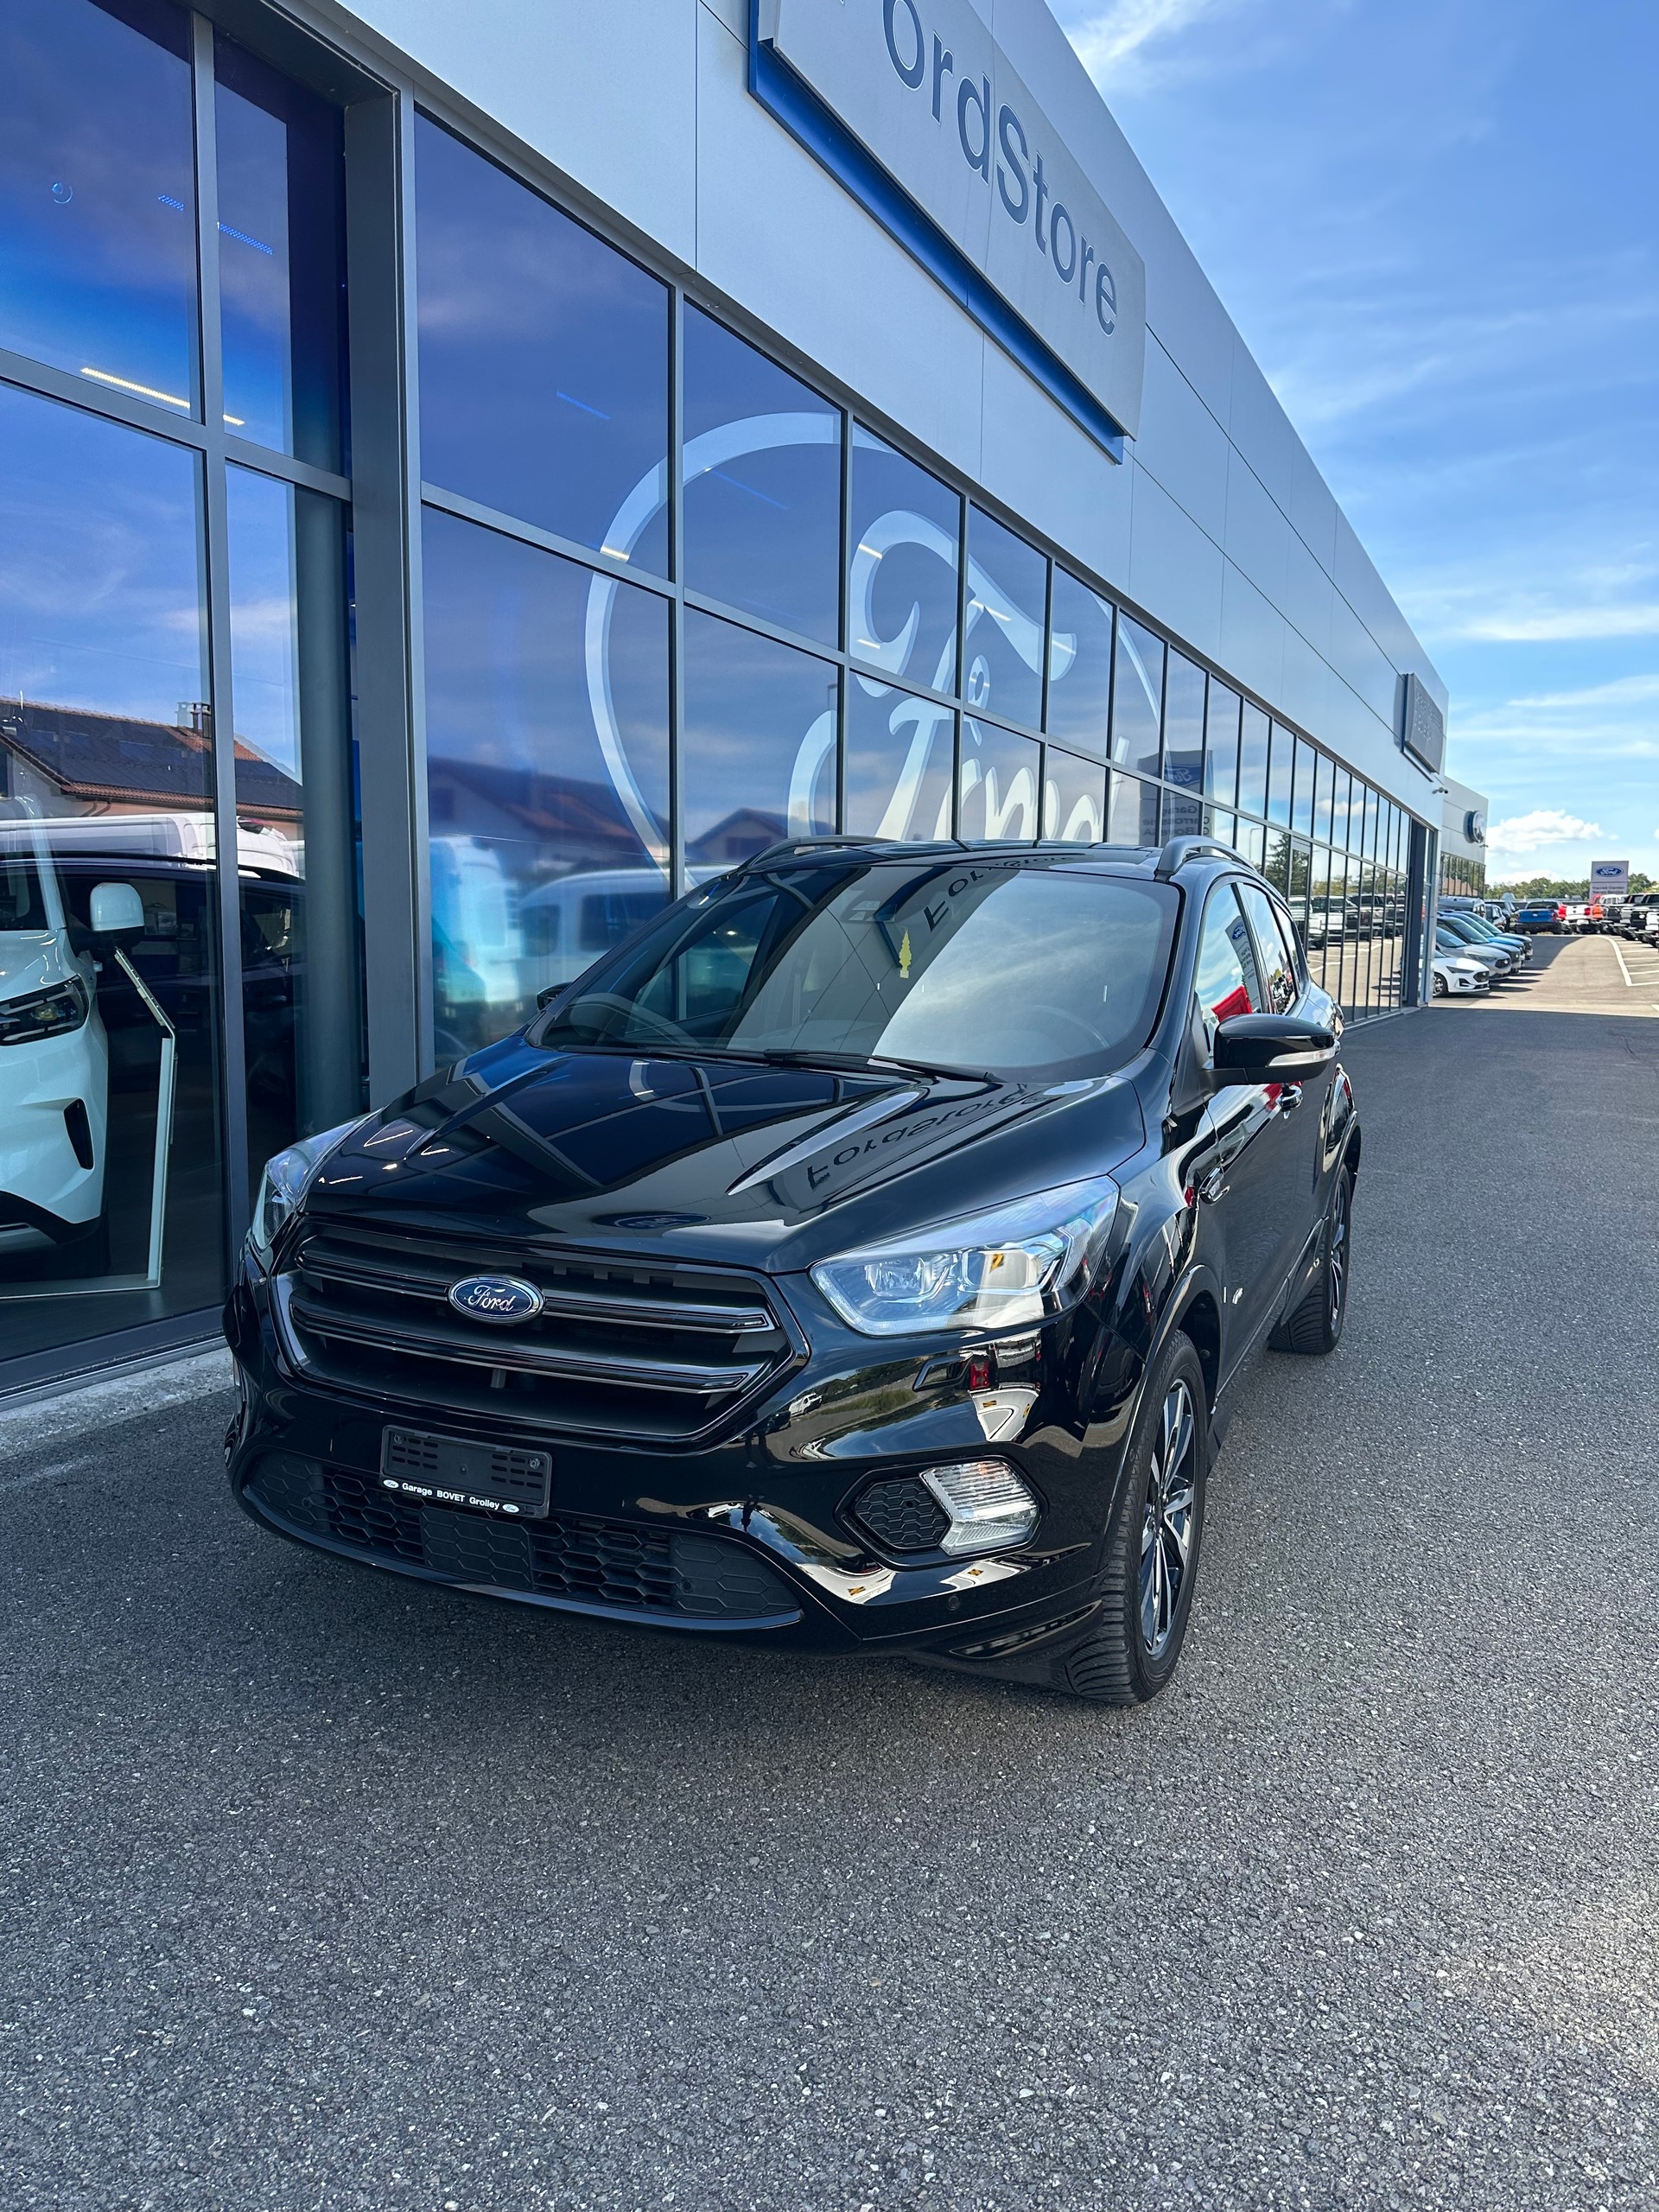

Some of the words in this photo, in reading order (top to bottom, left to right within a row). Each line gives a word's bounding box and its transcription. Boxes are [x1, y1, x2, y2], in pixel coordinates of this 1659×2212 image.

[838, 0, 1117, 337] ordStore
[467, 1285, 517, 1312] Ford
[402, 1483, 432, 1496] Garage
[436, 1490, 466, 1503] BOVET
[469, 1497, 500, 1510] Grolley
